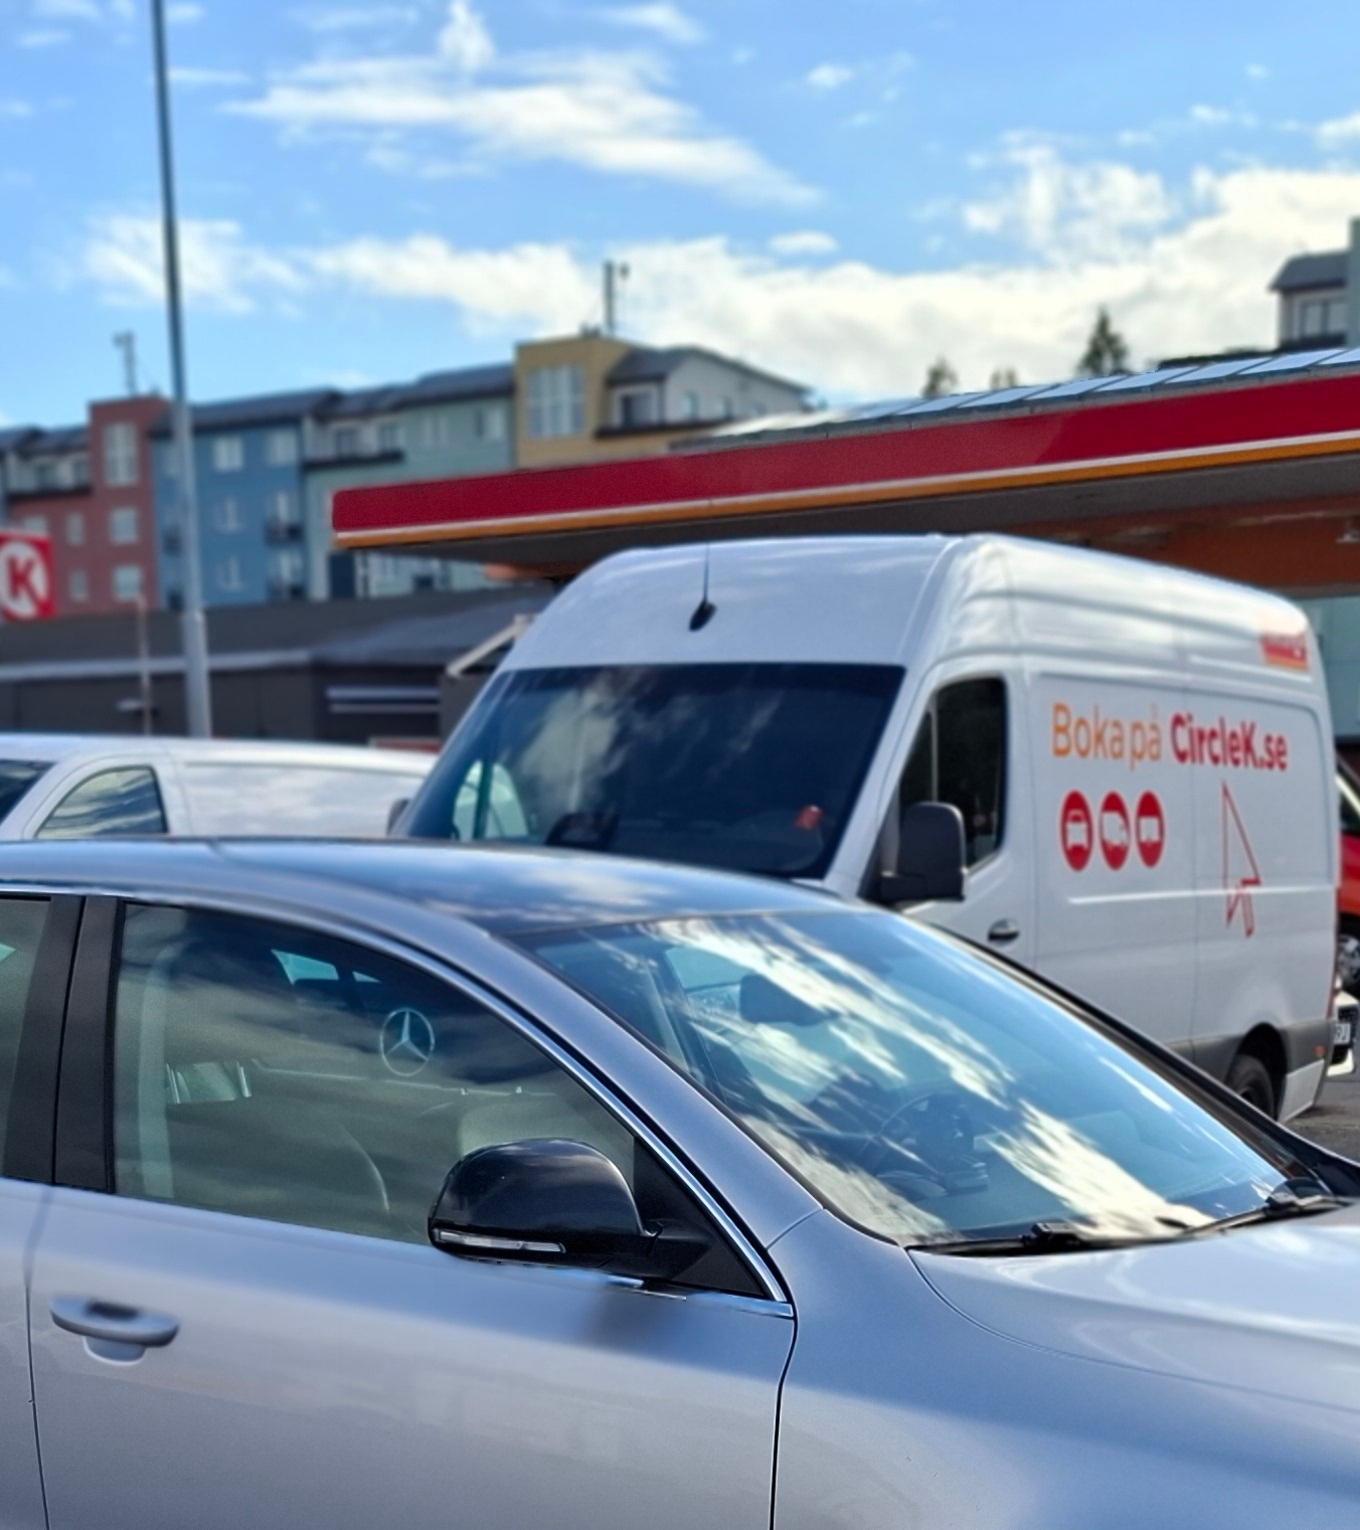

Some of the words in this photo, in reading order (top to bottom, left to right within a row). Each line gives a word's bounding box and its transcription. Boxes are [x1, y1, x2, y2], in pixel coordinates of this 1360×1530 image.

[1052, 702, 1124, 760] Boka
[1129, 703, 1162, 771] på
[1170, 712, 1288, 771] CircleK.se
